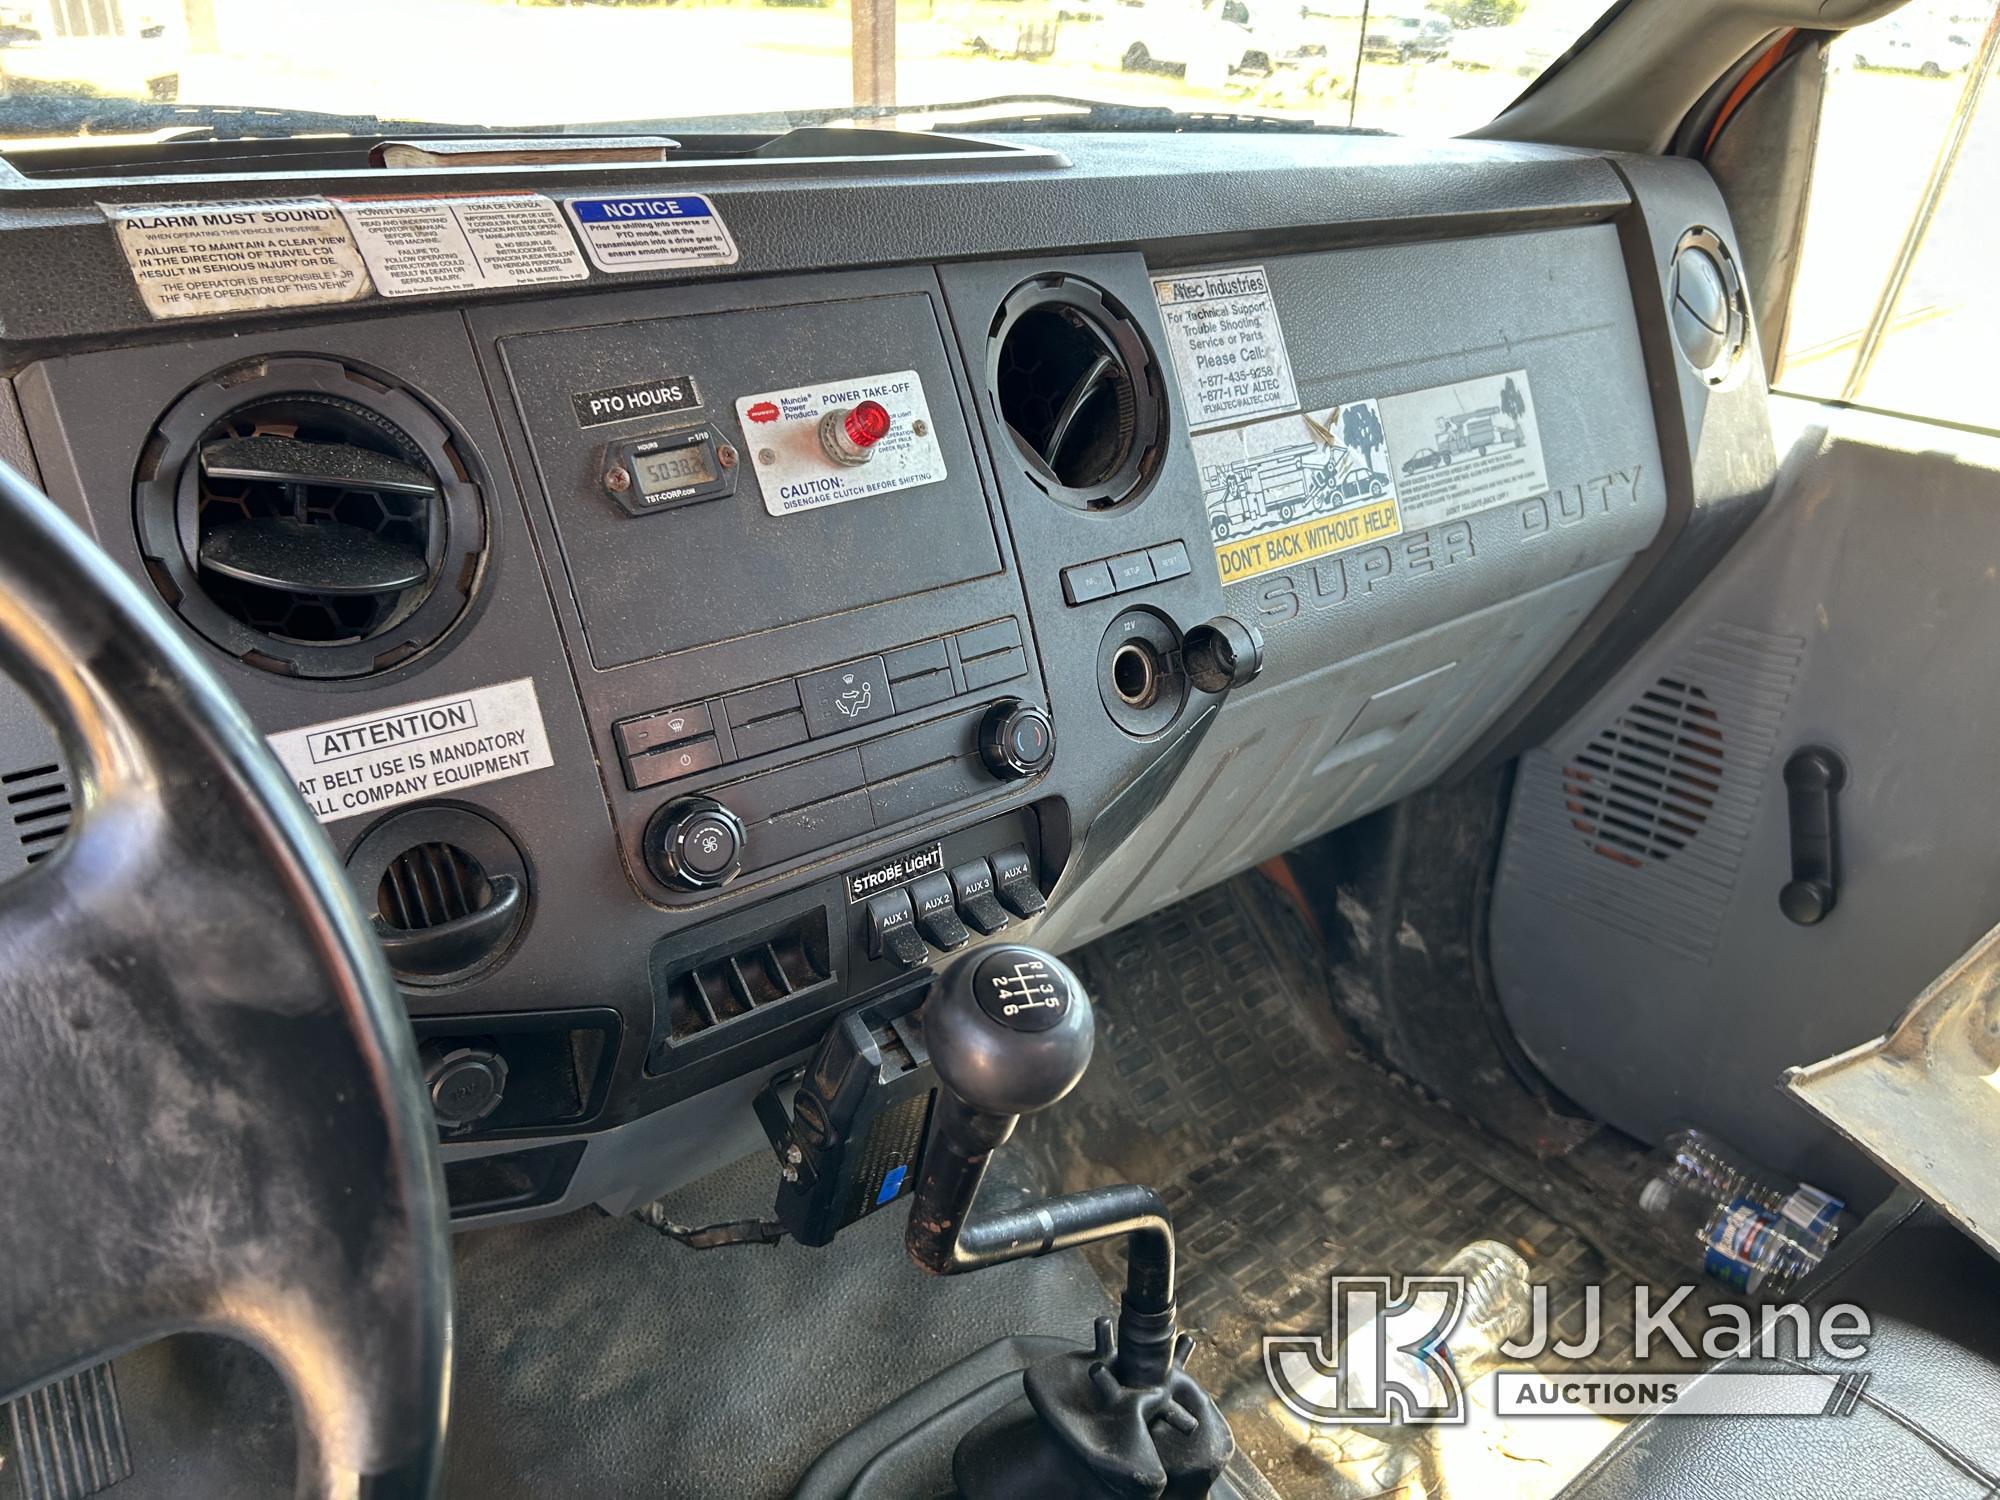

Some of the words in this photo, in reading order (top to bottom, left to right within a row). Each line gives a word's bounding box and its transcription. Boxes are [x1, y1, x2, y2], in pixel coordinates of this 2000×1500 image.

[357, 207, 394, 216] POWER
[395, 206, 437, 215] TAKE-OFF
[467, 203, 493, 211] TOMA
[494, 202, 506, 210] DE
[602, 201, 684, 218] NOTICE
[126, 216, 198, 230] ALARM
[202, 212, 256, 226] MUST
[262, 209, 337, 223] SOUND!
[400, 218, 448, 226] UNDERSTAND
[589, 224, 610, 232] Prior
[623, 221, 653, 231] shifting
[173, 230, 220, 239] OPERATING
[241, 227, 273, 235] VEHICLE
[616, 231, 634, 239] PTO
[636, 230, 662, 238] mode,
[662, 228, 680, 236] shift
[136, 245, 189, 256] FAILURE
[189, 244, 207, 252] TO
[209, 240, 265, 252] MAINTAIN
[278, 238, 317, 247] CLEAR
[318, 236, 346, 245] VIEW
[595, 240, 649, 249] transmission
[696, 236, 714, 245] gear
[139, 259, 152, 267] IN
[154, 257, 179, 266] THE
[181, 251, 246, 264] DIRECTION
[247, 250, 263, 259] OF
[265, 248, 312, 258] TRAVEL
[385, 256, 416, 264] FOLLOW
[417, 253, 458, 262] OPERATING
[398, 248, 428, 256] FAILURE
[608, 250, 636, 258] ensure
[637, 247, 668, 256] smooth
[669, 245, 721, 255] engagement.
[188, 266, 201, 275] IN
[204, 262, 256, 273] SERIOUS
[257, 259, 298, 270] INJURY
[301, 258, 318, 267] OR
[162, 282, 185, 292] THE
[186, 278, 249, 290] OPERATOR
[248, 277, 259, 285] IS
[260, 271, 331, 284] RESPONSIBLE
[1173, 283, 1205, 301] Altec
[1205, 276, 1264, 297] Industries
[160, 294, 181, 303] THE
[183, 291, 214, 301] SAFE
[214, 286, 275, 299] OPERATION
[277, 284, 292, 293] OF
[294, 282, 318, 291] THIS
[1167, 312, 1184, 324] For
[1186, 305, 1230, 322] Technical
[1231, 301, 1270, 316] Support,
[1183, 322, 1218, 337] Trouble
[1189, 335, 1225, 351] Service
[1227, 335, 1238, 345] or
[1239, 330, 1264, 343] Parts
[1196, 352, 1237, 369] Please
[1240, 346, 1265, 362] Call:
[1198, 365, 1274, 389] 1-877-435-9258
[822, 390, 861, 406] POWER
[862, 382, 911, 399] TAKE-OFF
[1234, 383, 1250, 397] FLY
[1252, 378, 1281, 393] ALTEC
[590, 396, 625, 416] PTO
[626, 385, 683, 409] HOURS
[782, 403, 806, 413] Power
[784, 409, 819, 421] Products
[637, 442, 659, 451] HOURS
[645, 487, 696, 504] TST-CORP.COM
[780, 476, 845, 500] CAUTION:
[783, 493, 832, 510] DISENGAGE
[833, 486, 865, 500] CLUTCH
[866, 480, 898, 493] BEFORE
[899, 472, 932, 486] SHIFTING
[1220, 543, 1262, 576] DON'T
[1266, 532, 1303, 563] BACK
[1304, 518, 1361, 553] WITHOUT
[1363, 510, 1398, 538] HELP!
[1255, 520, 1477, 627] SUPER
[1517, 462, 1644, 543] DUTY
[1123, 566, 1140, 577] SETUP
[1123, 620, 1136, 631] 12V
[323, 705, 467, 756] ATTENTION
[323, 767, 364, 791] BELT
[368, 758, 405, 780] USE
[408, 753, 426, 771] IS
[430, 729, 526, 765] MANDATORY
[342, 775, 429, 809] COMPANY
[434, 750, 530, 787] EQUIPMENT
[853, 864, 903, 893] STROBE
[905, 850, 940, 873] LIGHT
[1003, 867, 1022, 880] AUX
[1021, 864, 1028, 873] 4
[965, 882, 984, 895] AUX
[983, 878, 990, 888] 3
[924, 897, 944, 911] AUX
[943, 894, 950, 903] 2
[883, 913, 902, 927] AUX
[903, 911, 909, 919] 1
[1029, 961, 1044, 970] R
[992, 976, 1008, 987] 2
[1039, 984, 1054, 993] 3
[998, 989, 1014, 999] 4
[1044, 997, 1060, 1008] 5
[1003, 1005, 1019, 1016] 6
